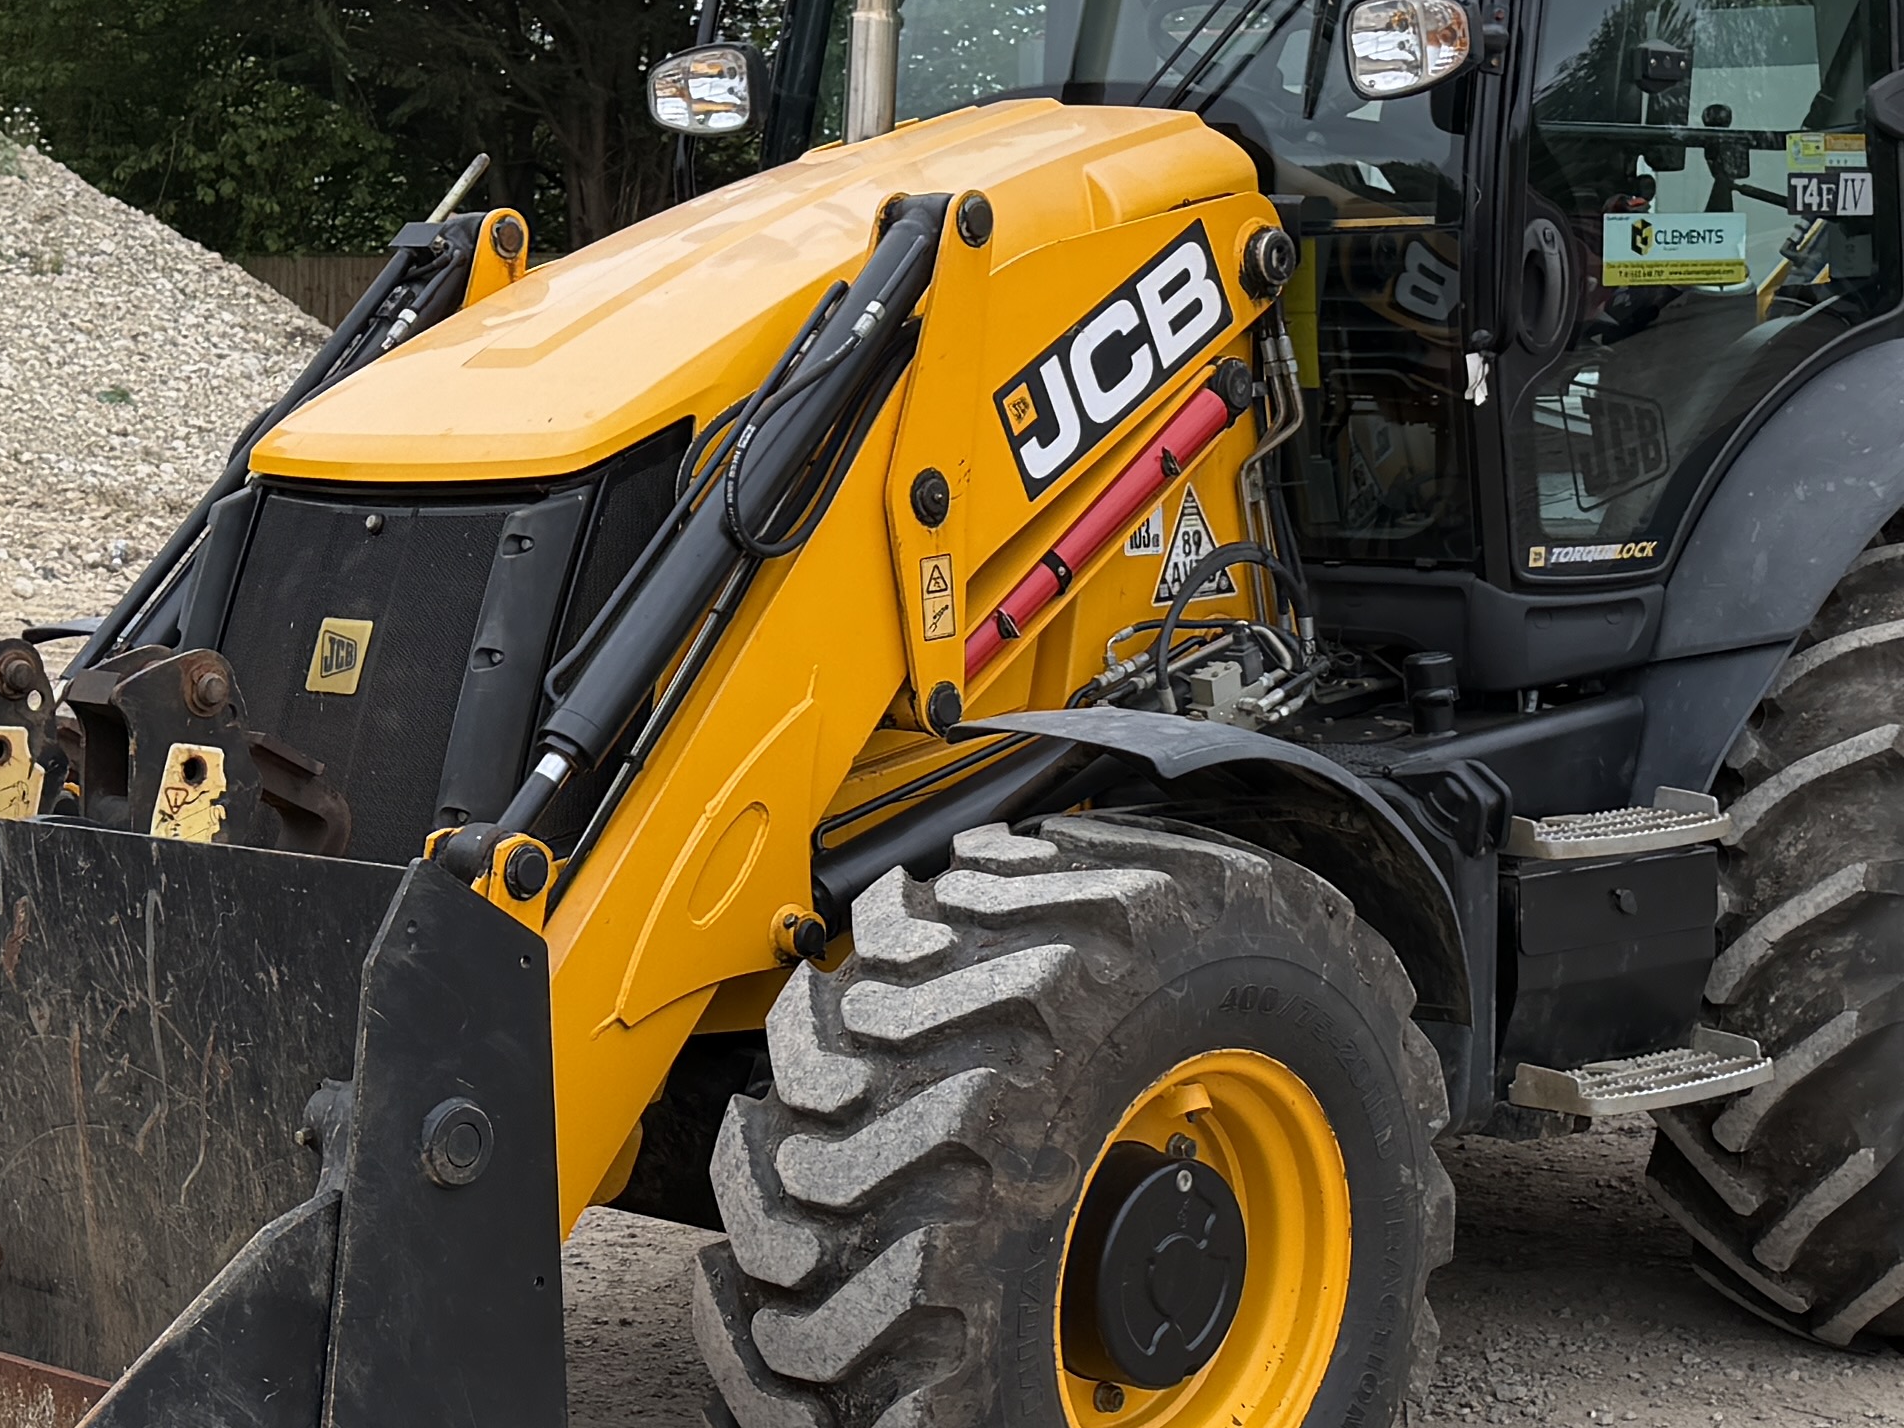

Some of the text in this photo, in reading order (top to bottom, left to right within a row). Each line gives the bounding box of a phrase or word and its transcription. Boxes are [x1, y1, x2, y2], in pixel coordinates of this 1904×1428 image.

[1790, 177, 1836, 212] T4F
[1654, 228, 1724, 246] CLEMENTS
[1019, 241, 1222, 480] JCB
[1577, 394, 1663, 498] JCB
[1181, 529, 1202, 557] 89
[322, 633, 356, 675] JCB
